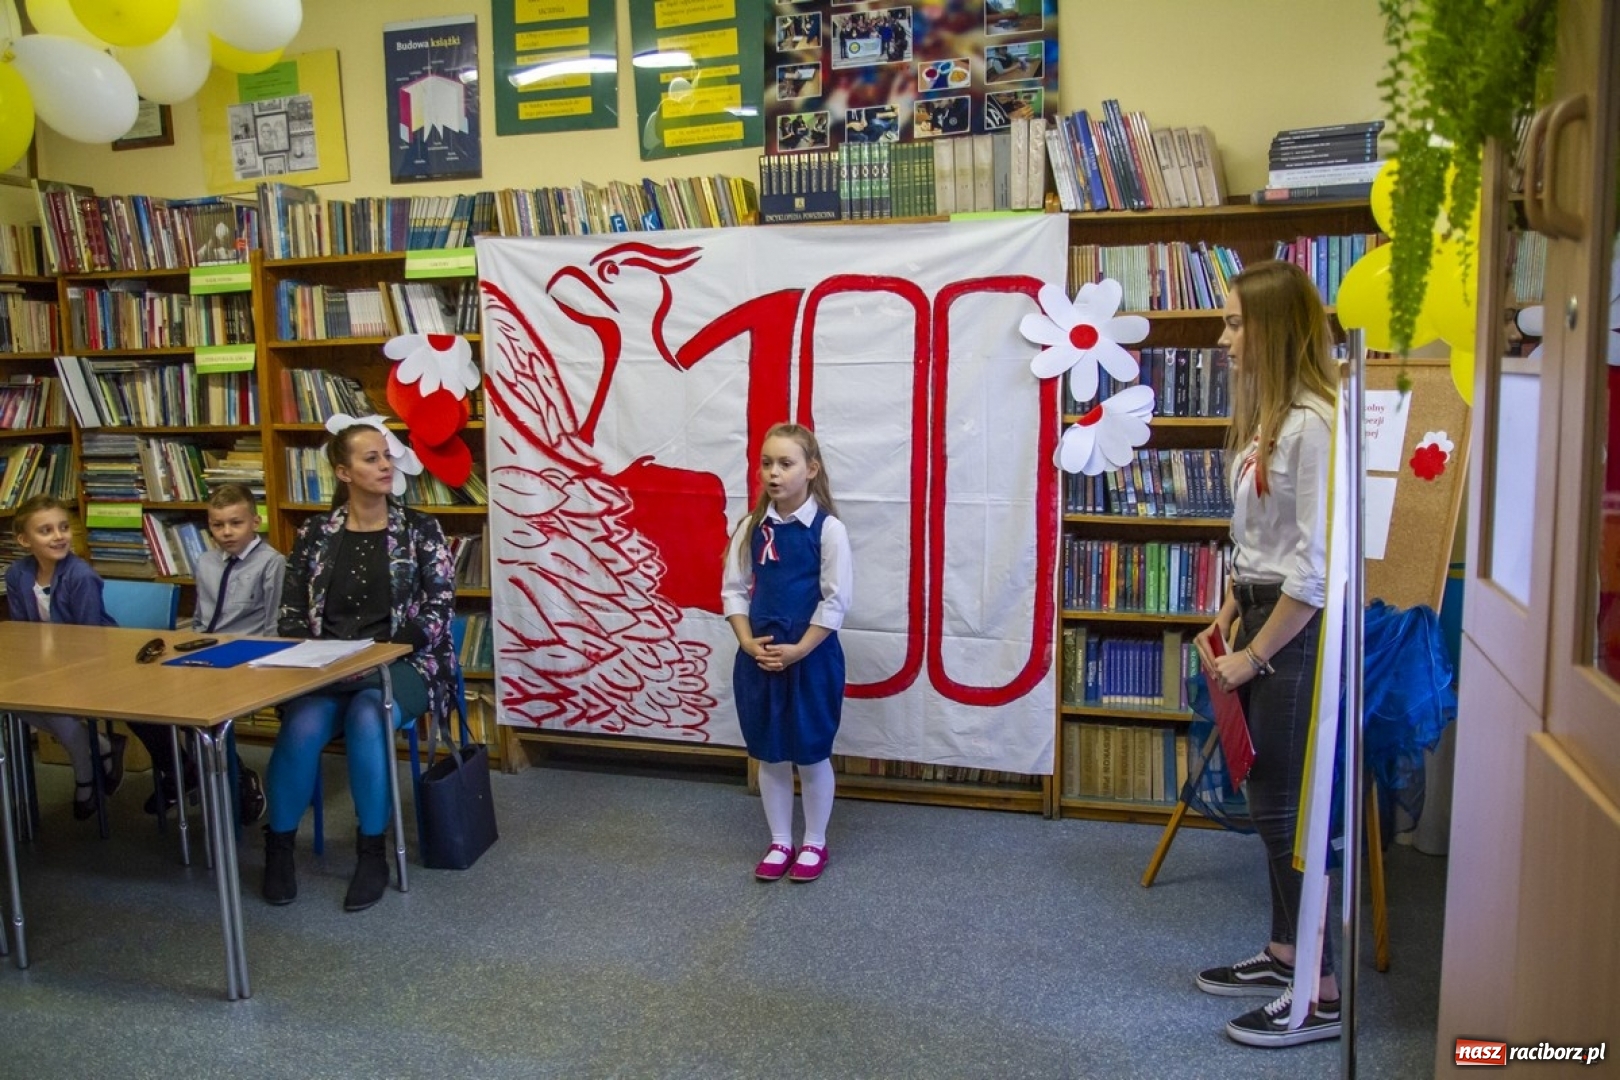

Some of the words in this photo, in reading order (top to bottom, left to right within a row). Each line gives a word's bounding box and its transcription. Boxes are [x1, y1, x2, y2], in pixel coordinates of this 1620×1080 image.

[396, 41, 430, 51] Budowa
[430, 36, 461, 48] książki
[613, 216, 622, 232] F
[644, 214, 656, 231] K
